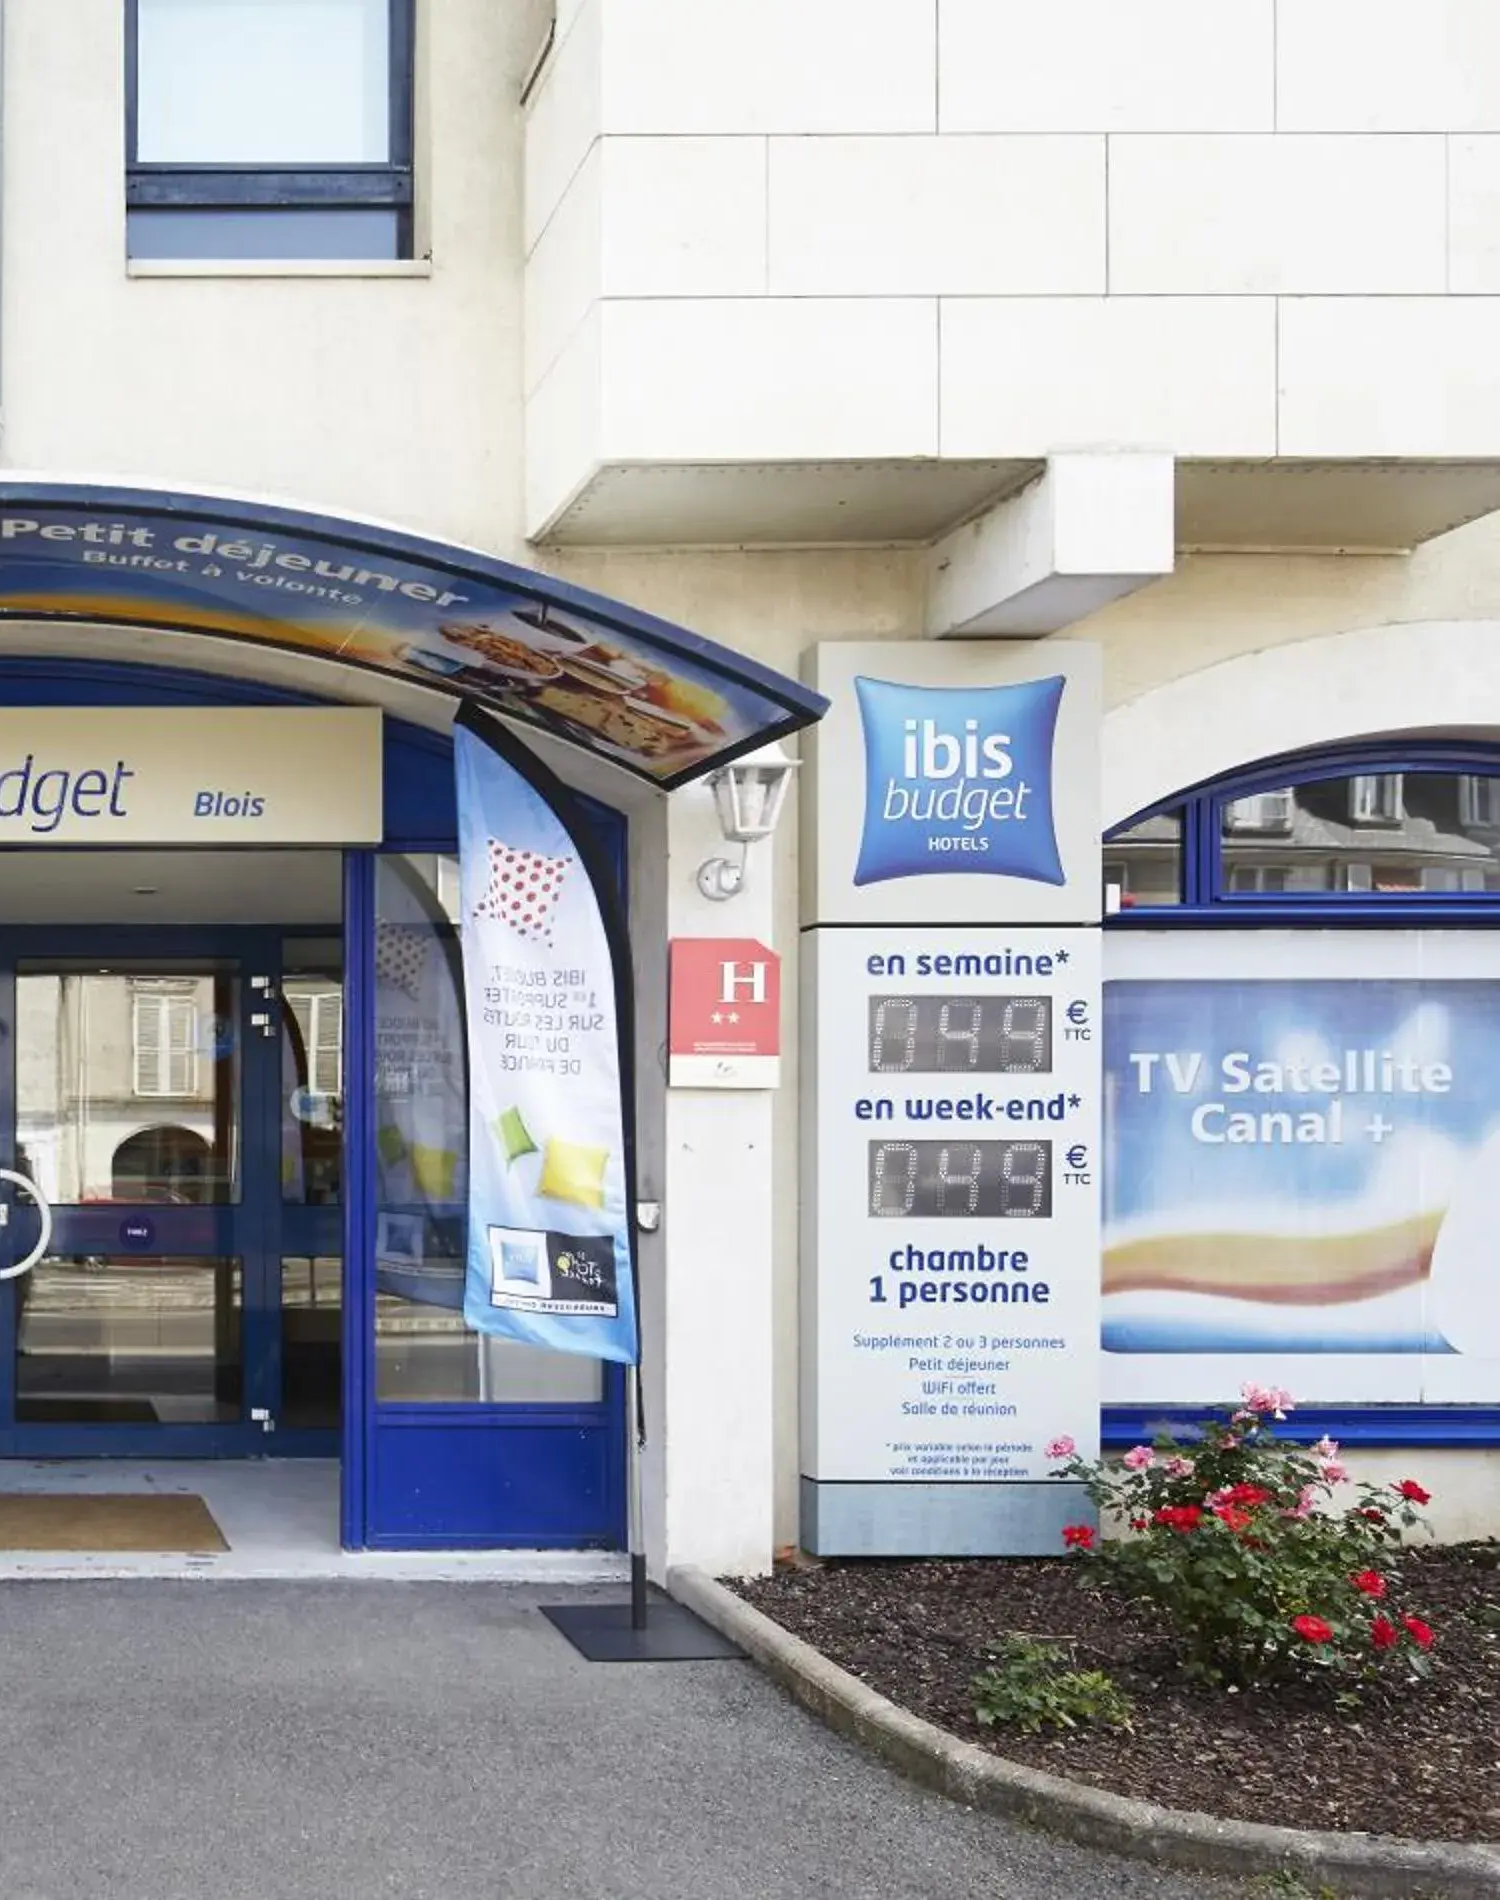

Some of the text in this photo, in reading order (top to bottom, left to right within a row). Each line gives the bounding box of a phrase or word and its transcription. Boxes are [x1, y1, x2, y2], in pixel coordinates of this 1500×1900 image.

[0, 517, 471, 608] Petit déjeuner
[82, 549, 189, 575] Buffet
[236, 570, 365, 606] volonté
[903, 719, 1013, 779] ibis
[193, 790, 267, 818] Blois
[883, 778, 1032, 830] budget
[928, 836, 989, 851] HOTELS
[866, 954, 905, 976] en
[718, 961, 771, 1003] H
[1065, 1000, 1089, 1024] €
[1064, 1029, 1091, 1041] TTC
[1129, 1050, 1453, 1093] TV Satellite
[855, 1098, 893, 1120] en
[1191, 1099, 1342, 1144] Canal
[1065, 1144, 1089, 1169] €
[1064, 1173, 1091, 1185] TTC
[889, 1244, 1029, 1272] chambre
[869, 1275, 1050, 1309] 1 personne
[853, 1333, 1066, 1351] Supplément 2 ou 3 personnes
[908, 1357, 1010, 1373] Petit déjeuner
[922, 1381, 996, 1395] WiFi offert
[901, 1401, 1017, 1415] Salle de réunion
